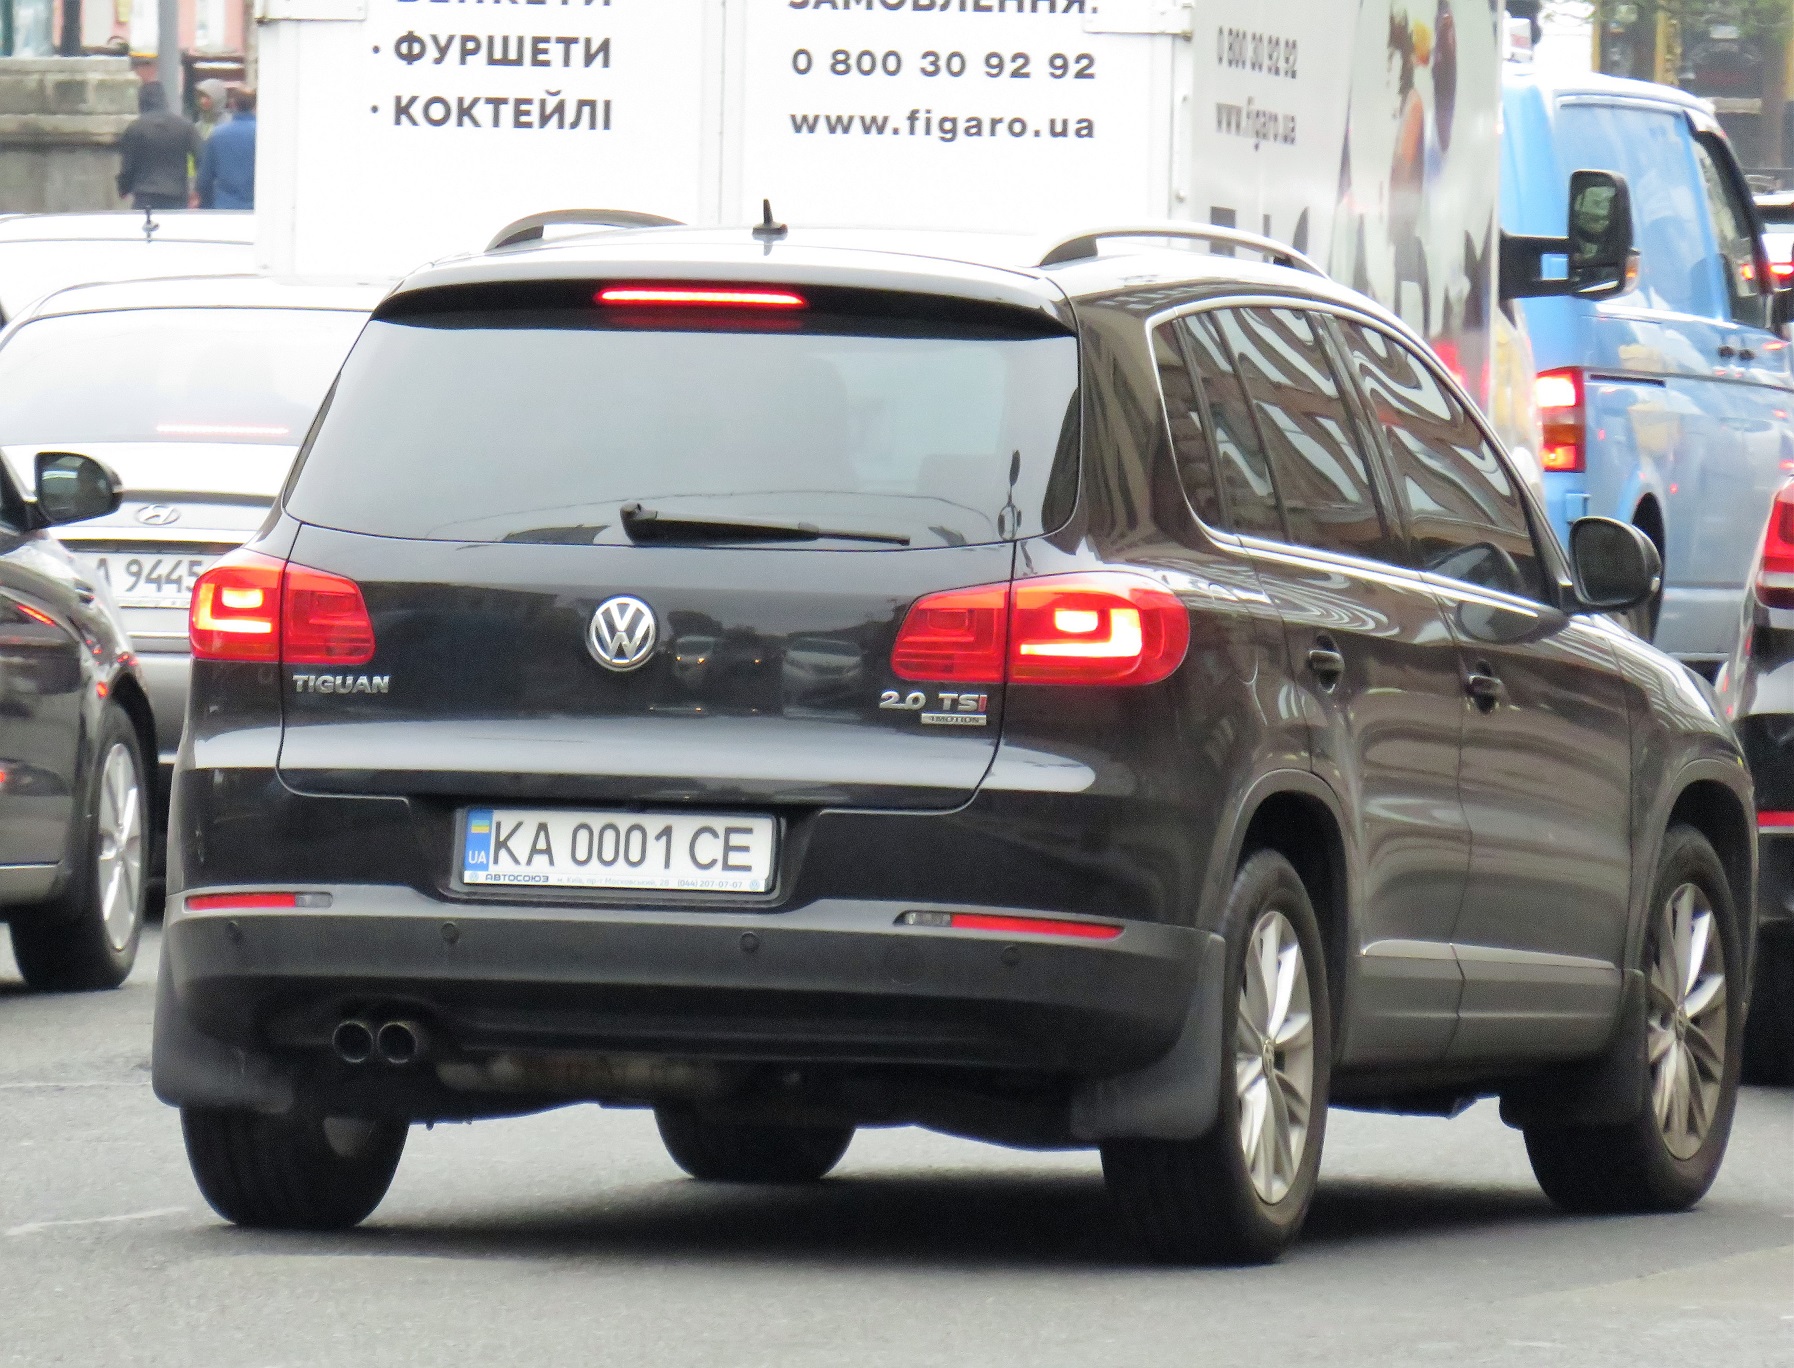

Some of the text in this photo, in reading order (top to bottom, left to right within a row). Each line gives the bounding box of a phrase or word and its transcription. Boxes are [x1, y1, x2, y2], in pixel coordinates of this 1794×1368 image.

[394, 31, 611, 68] ФУРШЕТИ
[792, 48, 1096, 80] 0 800 30 92 92
[1266, 35, 1281, 76] 92
[1283, 38, 1298, 79] 92
[394, 90, 611, 130] КОКТЕЙЛІ
[789, 109, 1095, 142] www.figaro.ua
[292, 674, 390, 694] TIGUAN
[468, 849, 487, 865] UA
[492, 820, 754, 872] KA 0001 CE
[485, 873, 549, 883] АВТОСОЮЗ
[677, 880, 698, 889] (044)
[699, 880, 743, 889] 207-07-07
